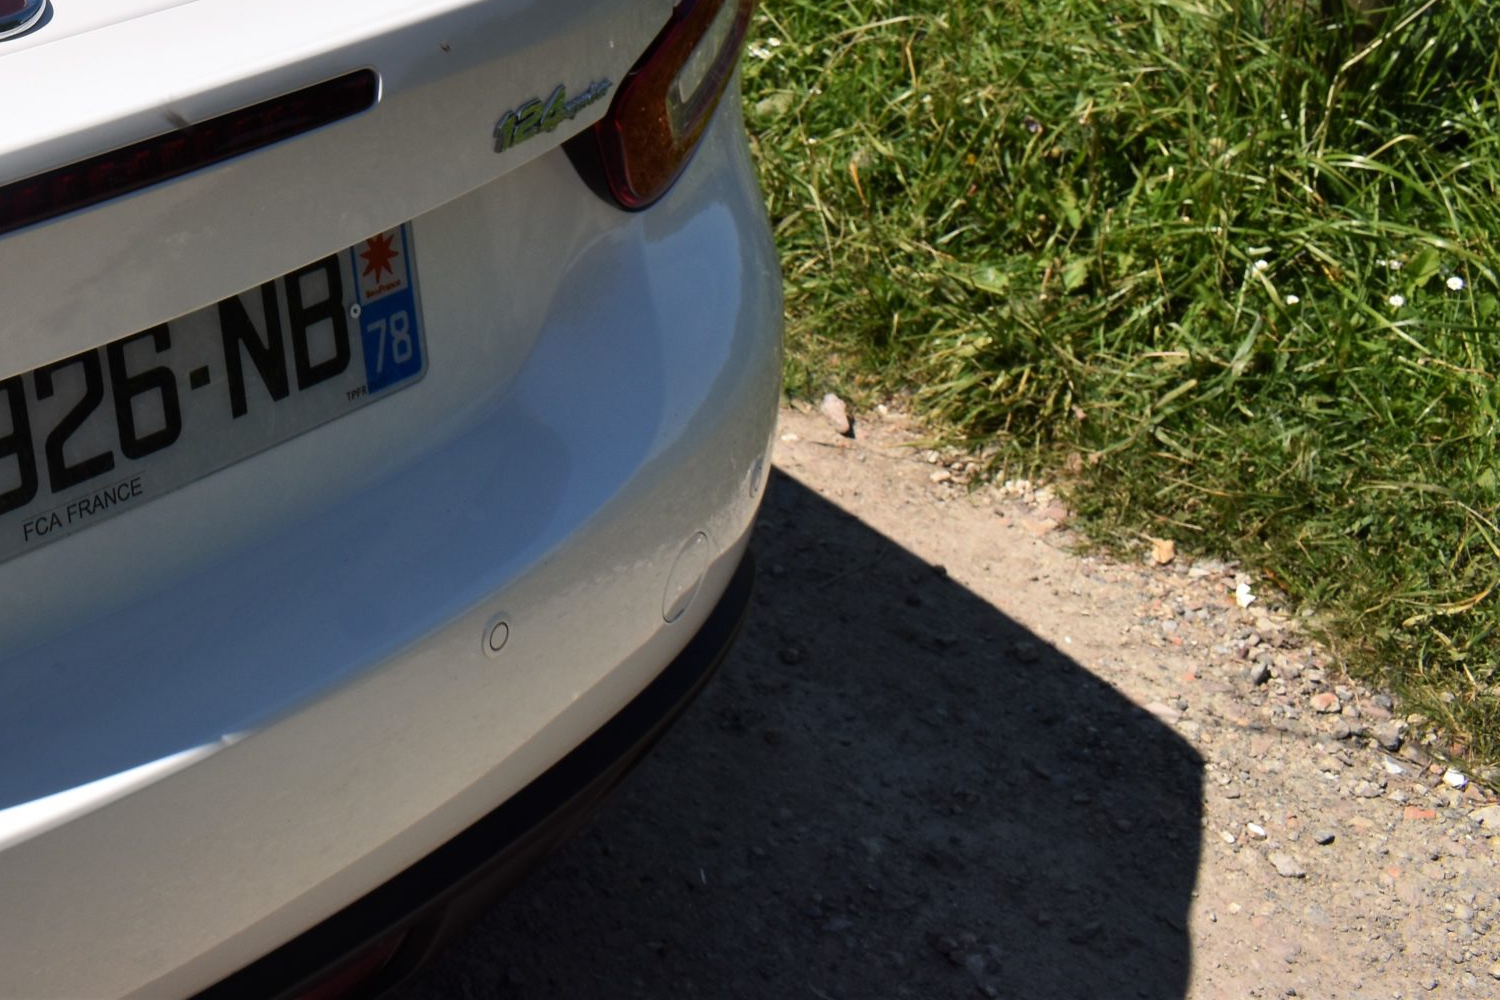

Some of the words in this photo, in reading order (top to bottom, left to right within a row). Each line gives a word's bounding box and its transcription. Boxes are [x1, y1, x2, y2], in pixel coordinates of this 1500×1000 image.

[493, 82, 566, 153] 124
[366, 309, 414, 374] 78
[22, 511, 63, 542] FCA
[66, 476, 143, 524] FRANCE
